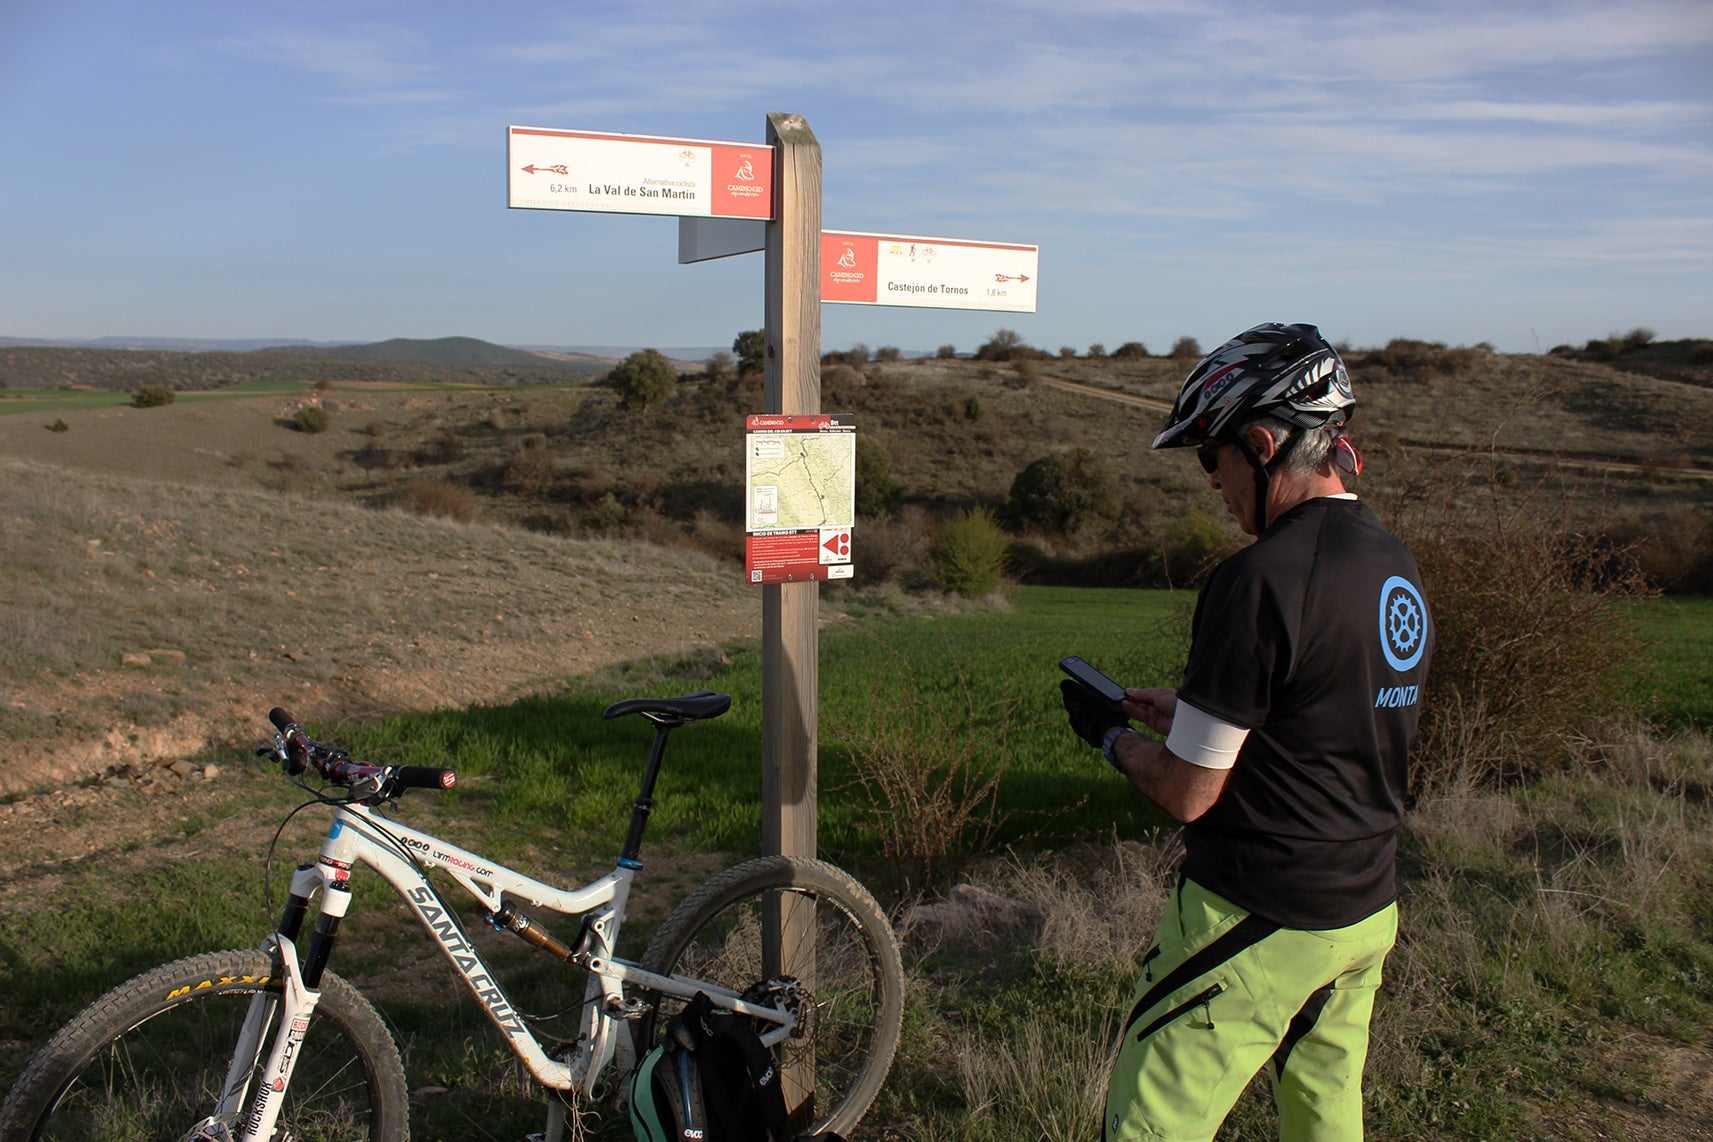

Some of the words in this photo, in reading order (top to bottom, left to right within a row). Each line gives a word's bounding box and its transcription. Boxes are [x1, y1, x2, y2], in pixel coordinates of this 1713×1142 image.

[550, 184, 562, 193] 6,2
[564, 184, 577, 193] km
[643, 178, 674, 186] Alternativa
[589, 184, 600, 194] La
[604, 185, 621, 195] Val
[624, 186, 636, 196] de
[640, 187, 658, 198] San
[888, 281, 925, 293] Castejón
[928, 284, 938, 293] de
[940, 284, 969, 295] Tornos
[997, 289, 1006, 297] km
[407, 886, 479, 974] SANTA
[469, 973, 526, 1039] CRUZ
[247, 1080, 273, 1136] ROCKSHOX
